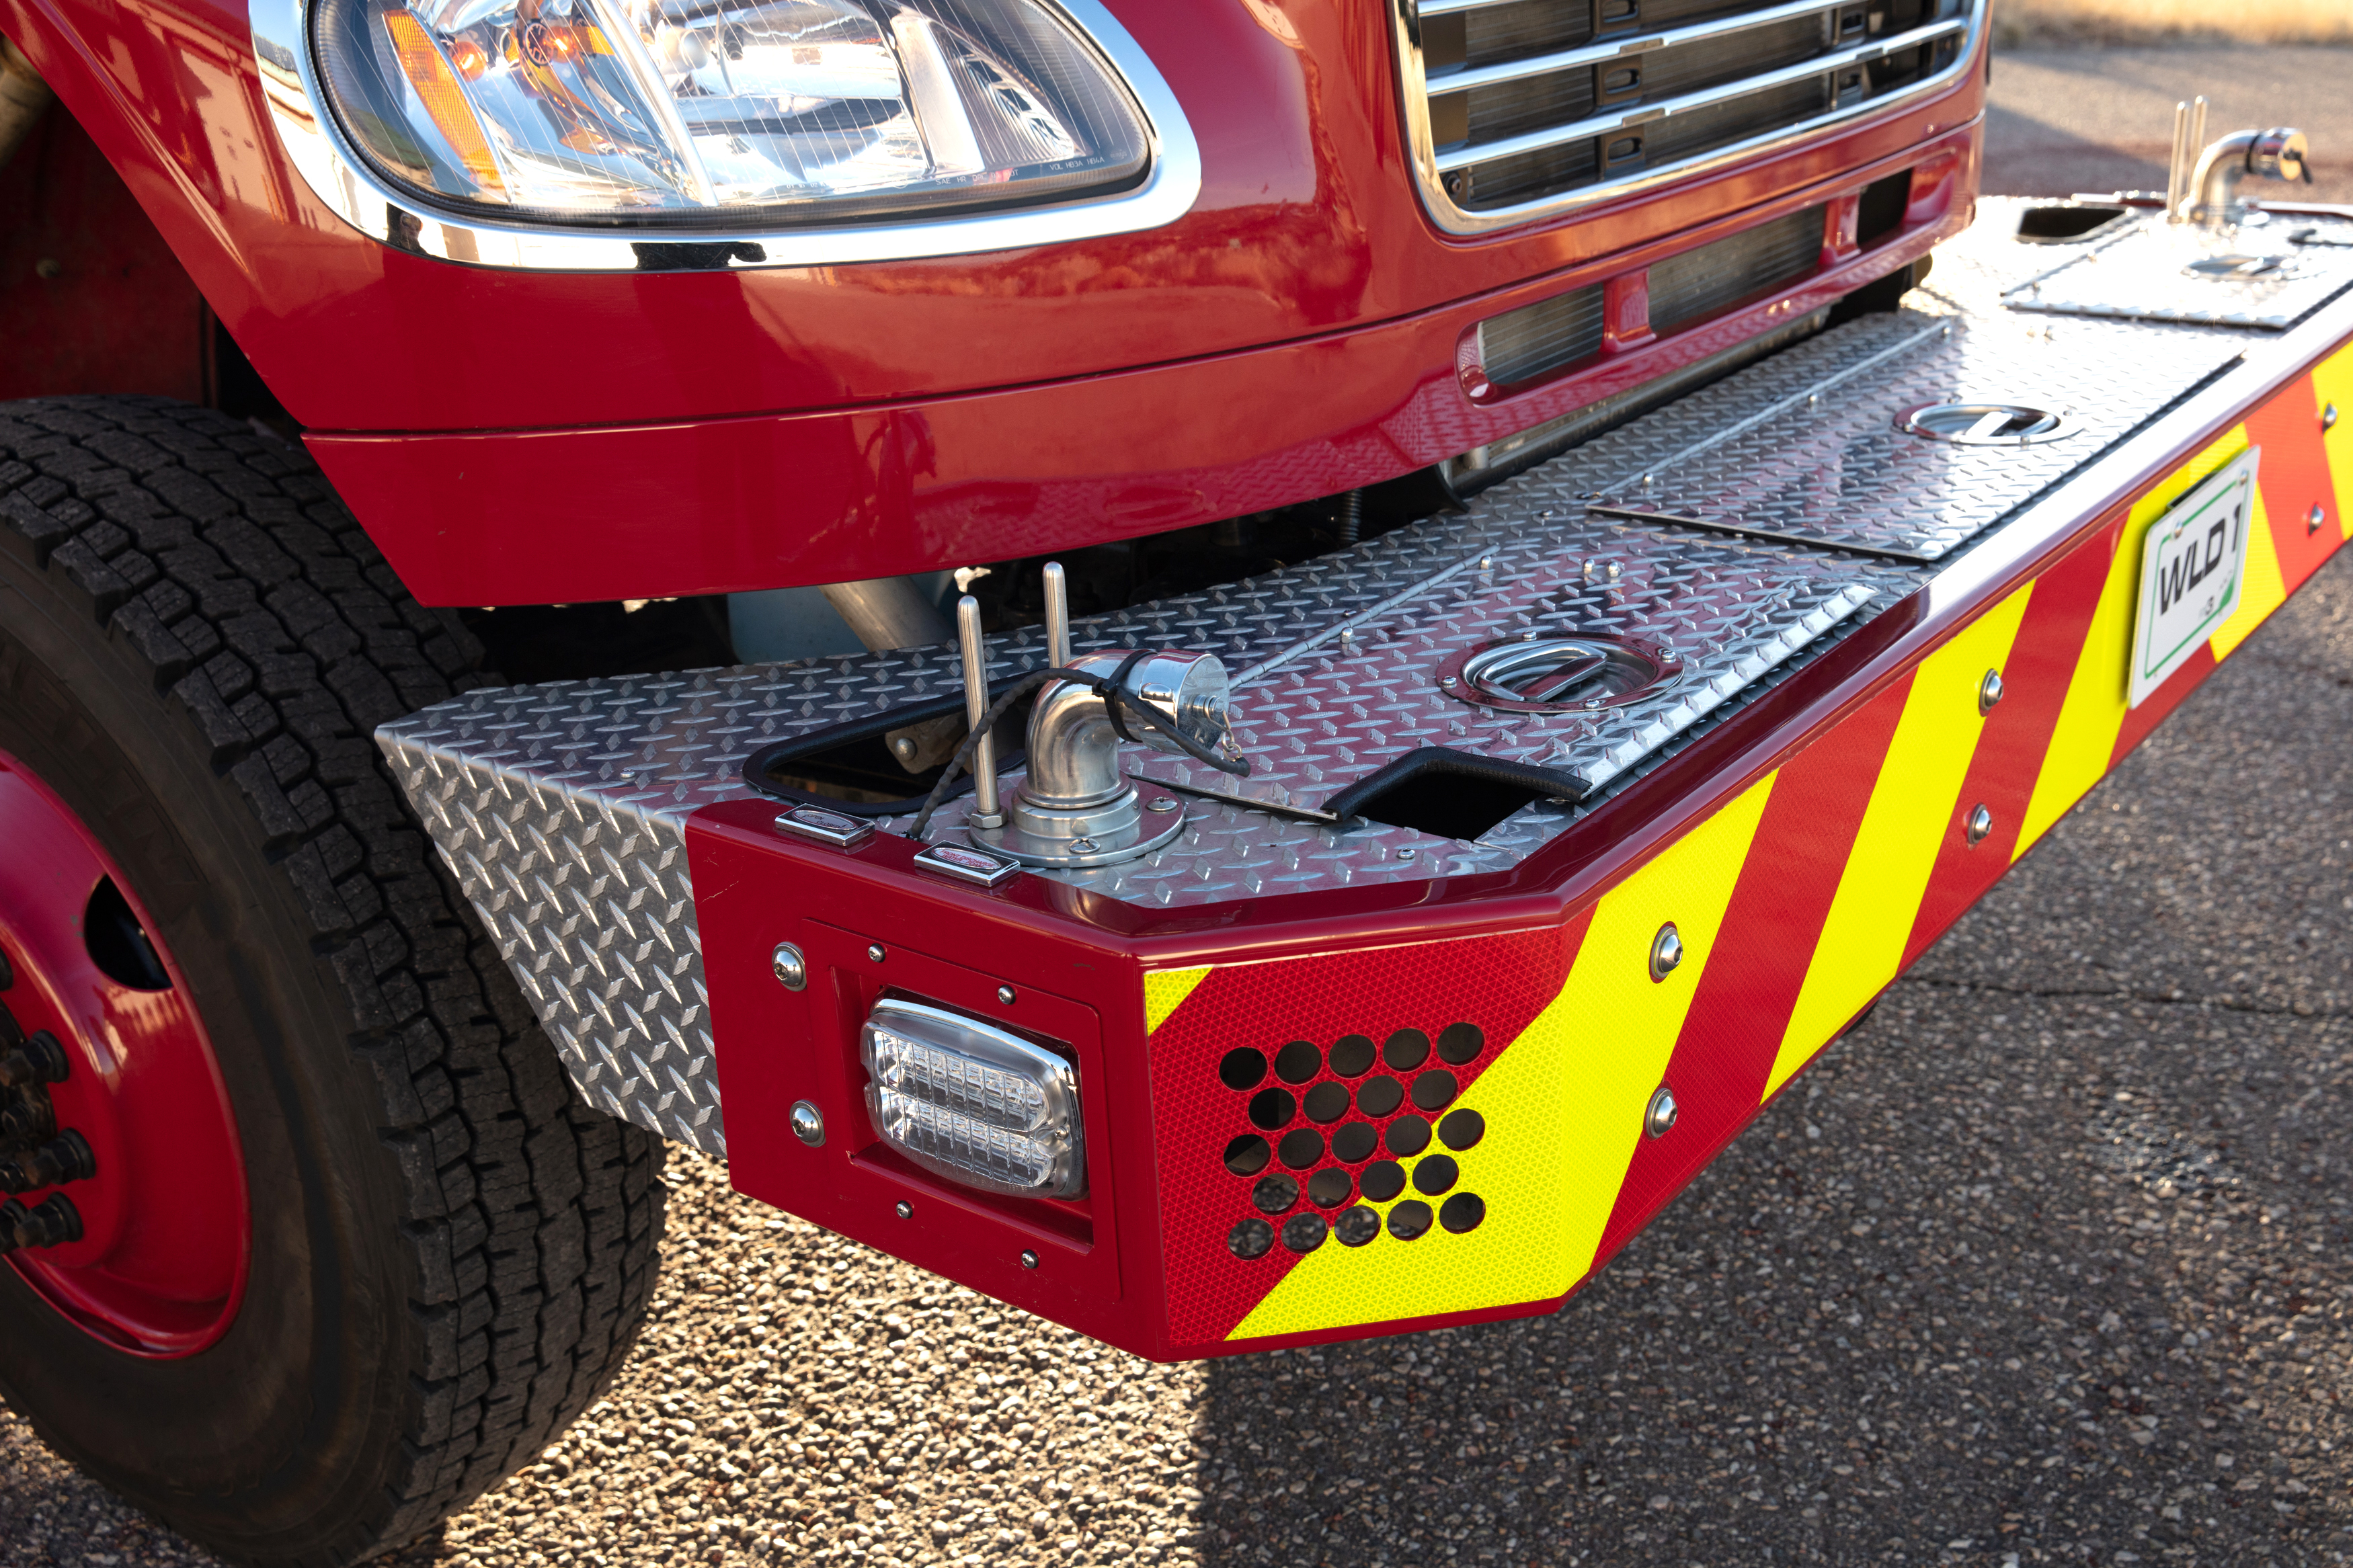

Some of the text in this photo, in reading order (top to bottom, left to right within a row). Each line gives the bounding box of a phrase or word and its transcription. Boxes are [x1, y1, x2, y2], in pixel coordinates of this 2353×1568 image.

[935, 177, 951, 185] SAE
[816, 820, 841, 829] CLOSED
[940, 850, 996, 867] FRONT DISCHARGE
[941, 854, 962, 862] WATER
[965, 860, 985, 868] FOAM
